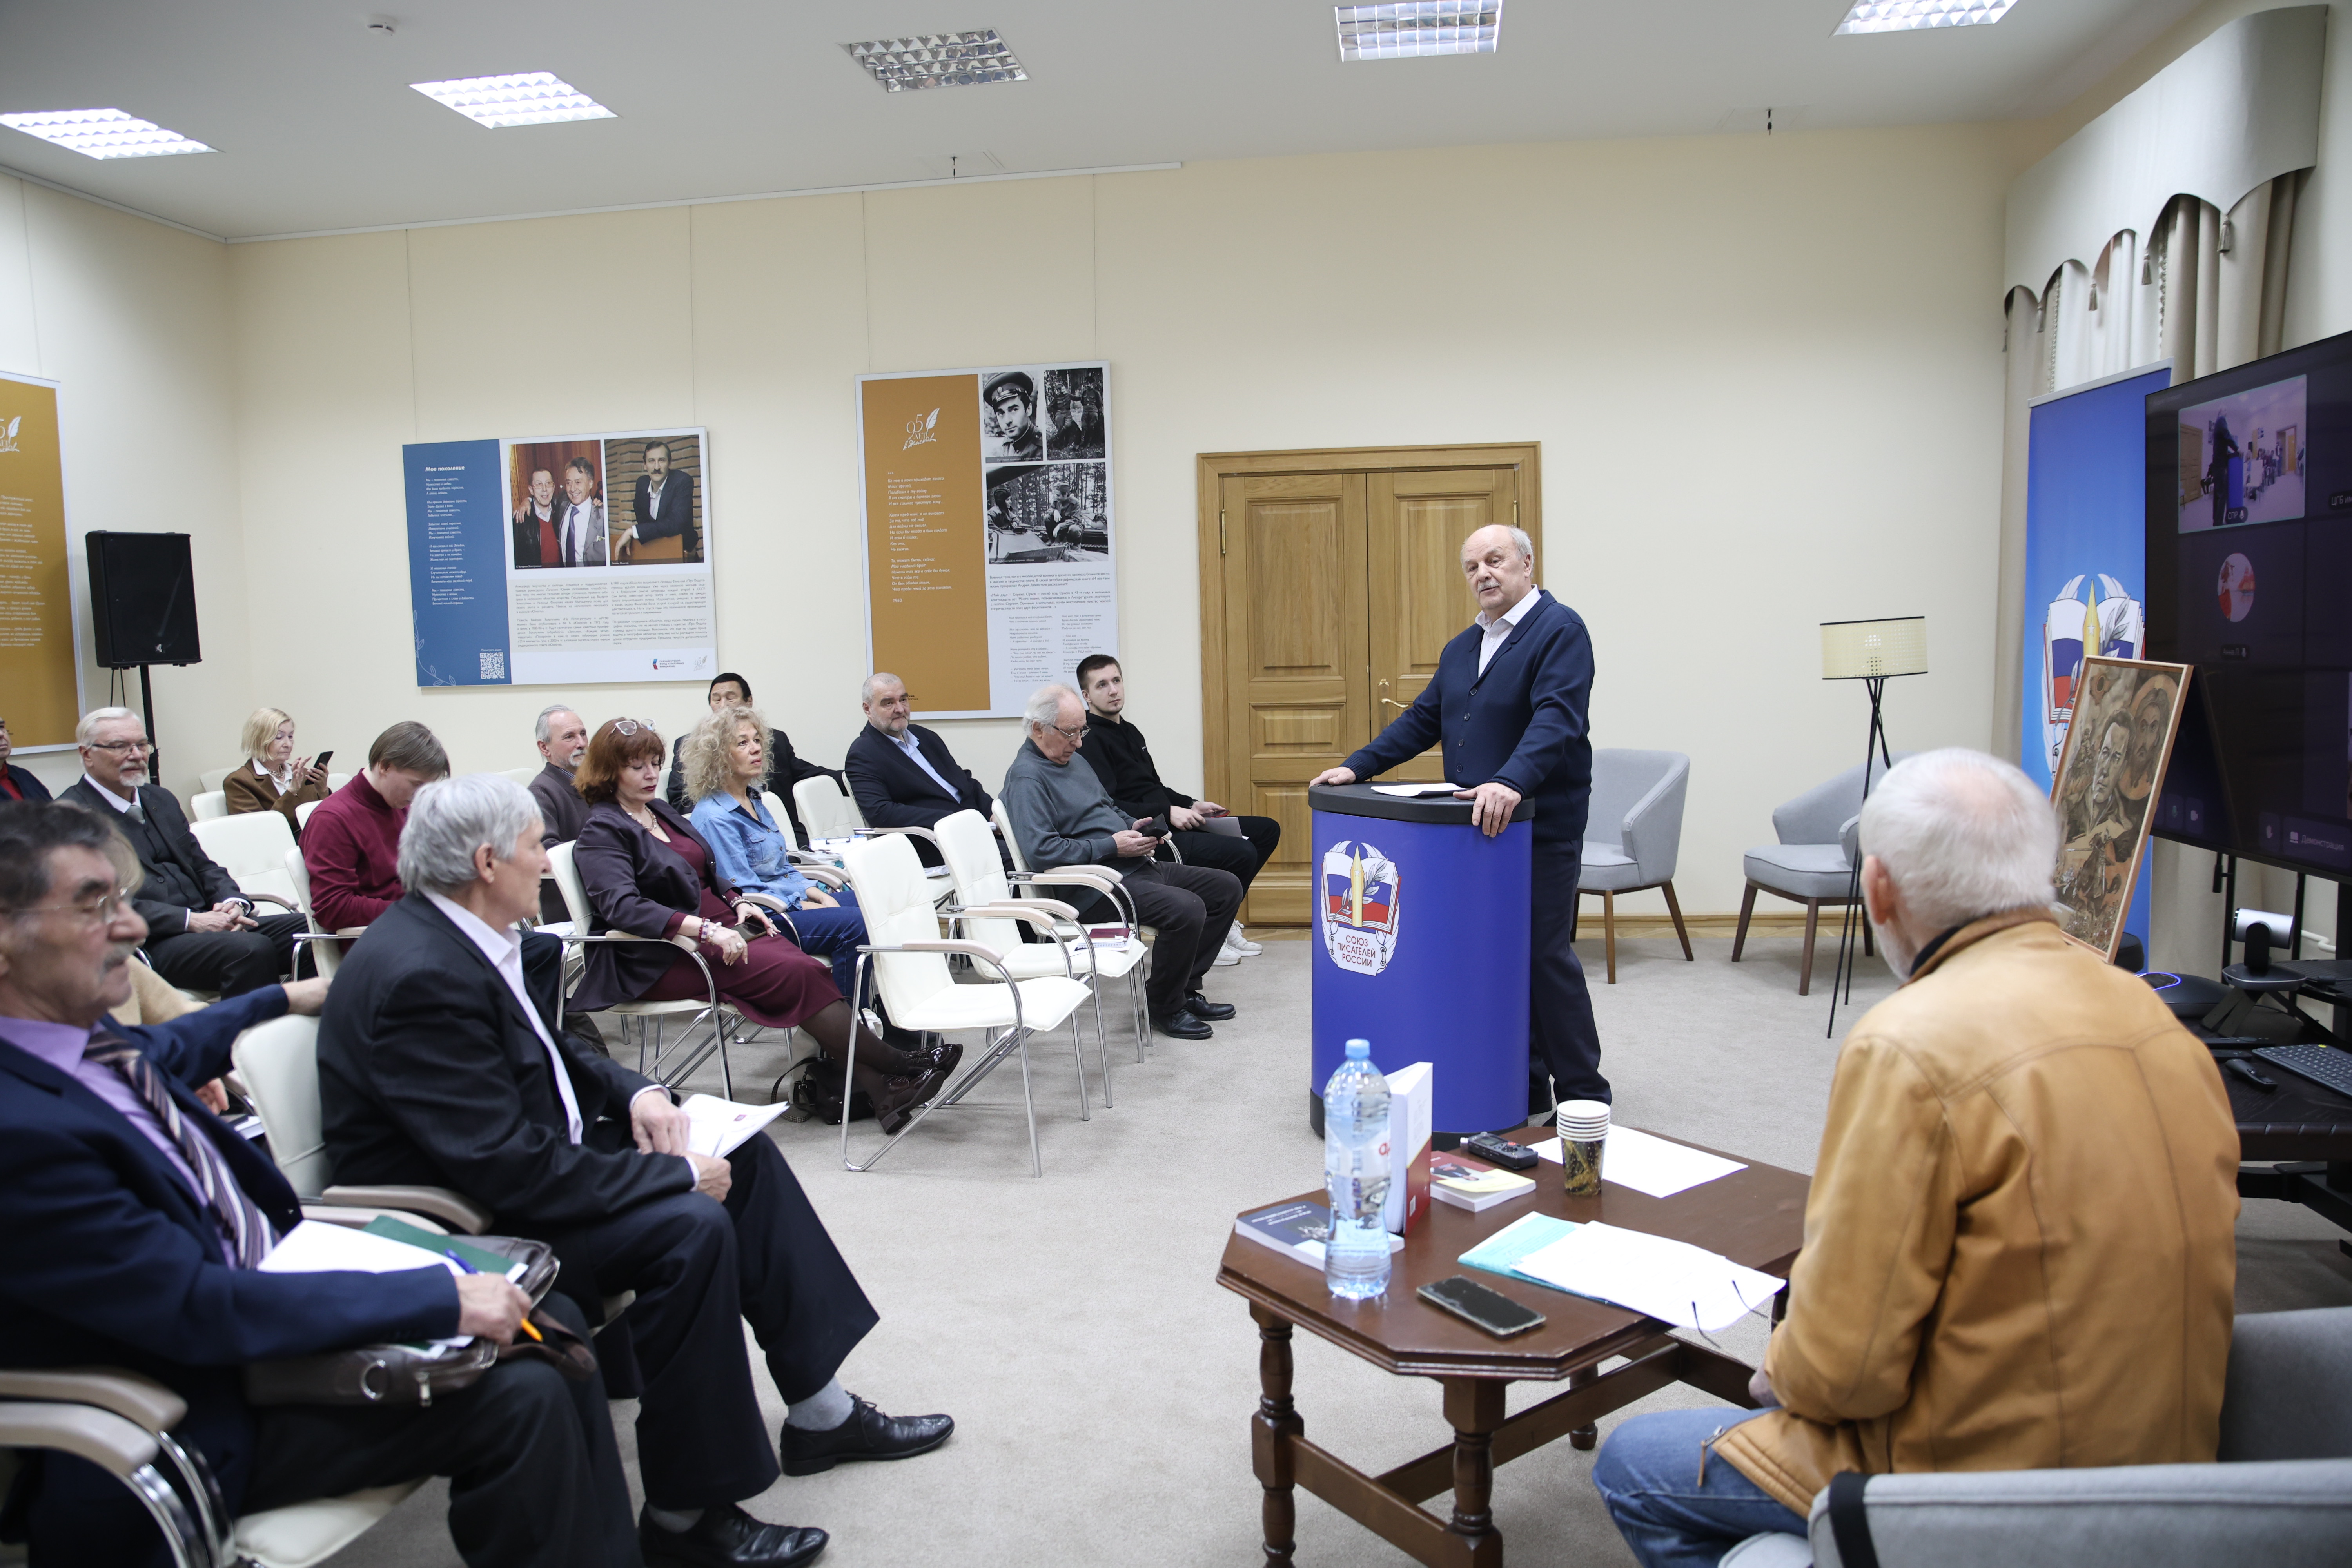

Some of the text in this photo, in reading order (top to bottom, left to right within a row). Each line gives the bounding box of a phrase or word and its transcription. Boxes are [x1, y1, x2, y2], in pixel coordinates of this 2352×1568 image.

[906, 414, 923, 440] 95
[2331, 495, 2343, 506] ЦГБ
[2228, 511, 2238, 520] СПР
[2301, 835, 2344, 851] Демонстрация
[1346, 935, 1368, 947] СОЮЗ
[1337, 942, 1376, 958] ПИСАТЕЛЕЙ
[1342, 953, 1372, 967] РОССИИ
